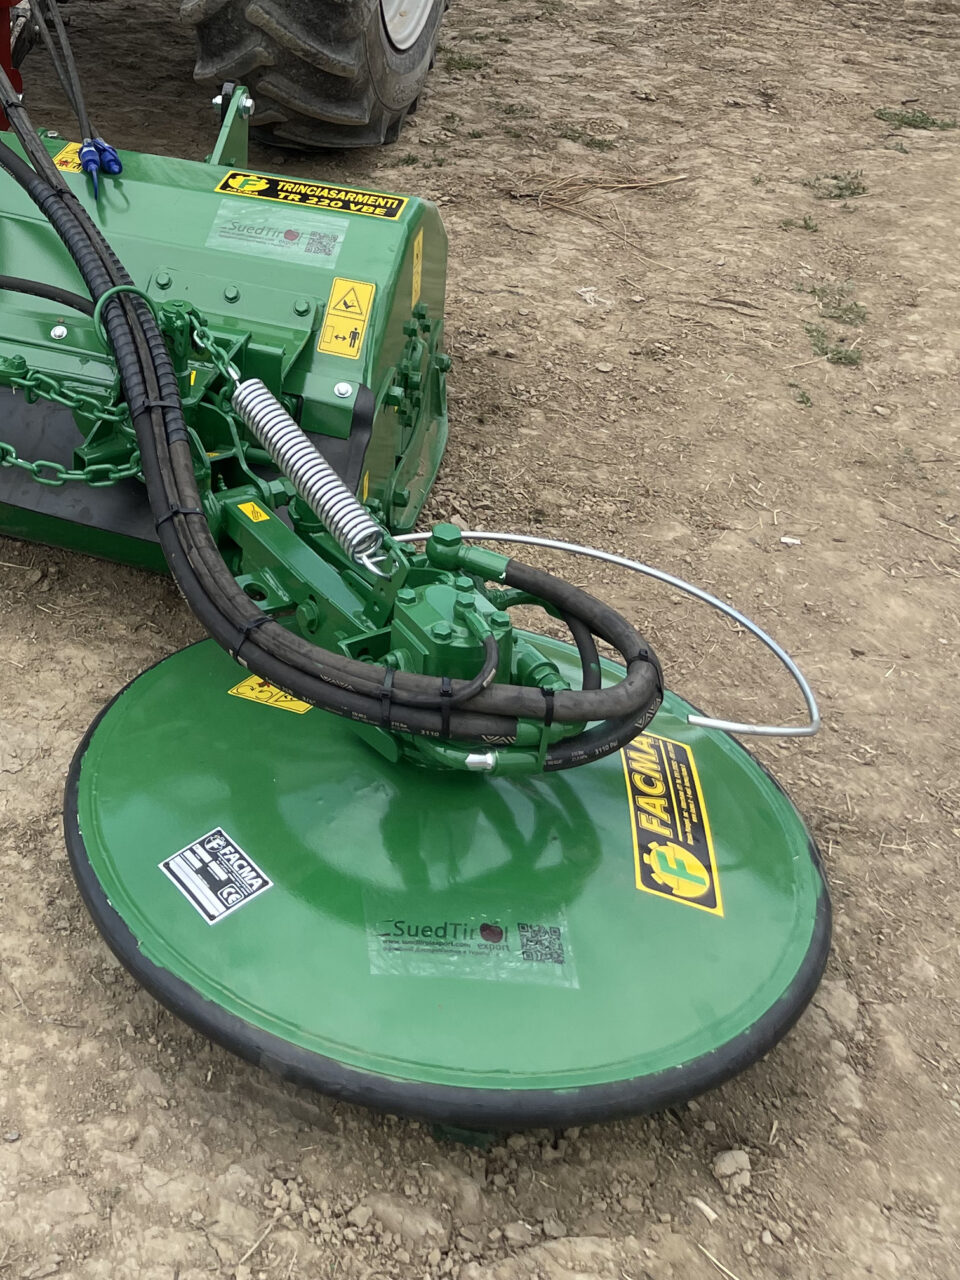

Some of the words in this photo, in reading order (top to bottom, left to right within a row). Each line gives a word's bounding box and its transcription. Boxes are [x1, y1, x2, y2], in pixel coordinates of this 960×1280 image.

[276, 181, 399, 209] TRINCIASARMENTI
[276, 191, 302, 202] TR
[308, 196, 343, 208] 220
[349, 202, 388, 216] VBE
[627, 732, 674, 839] FACMA
[219, 845, 263, 892] FACMA
